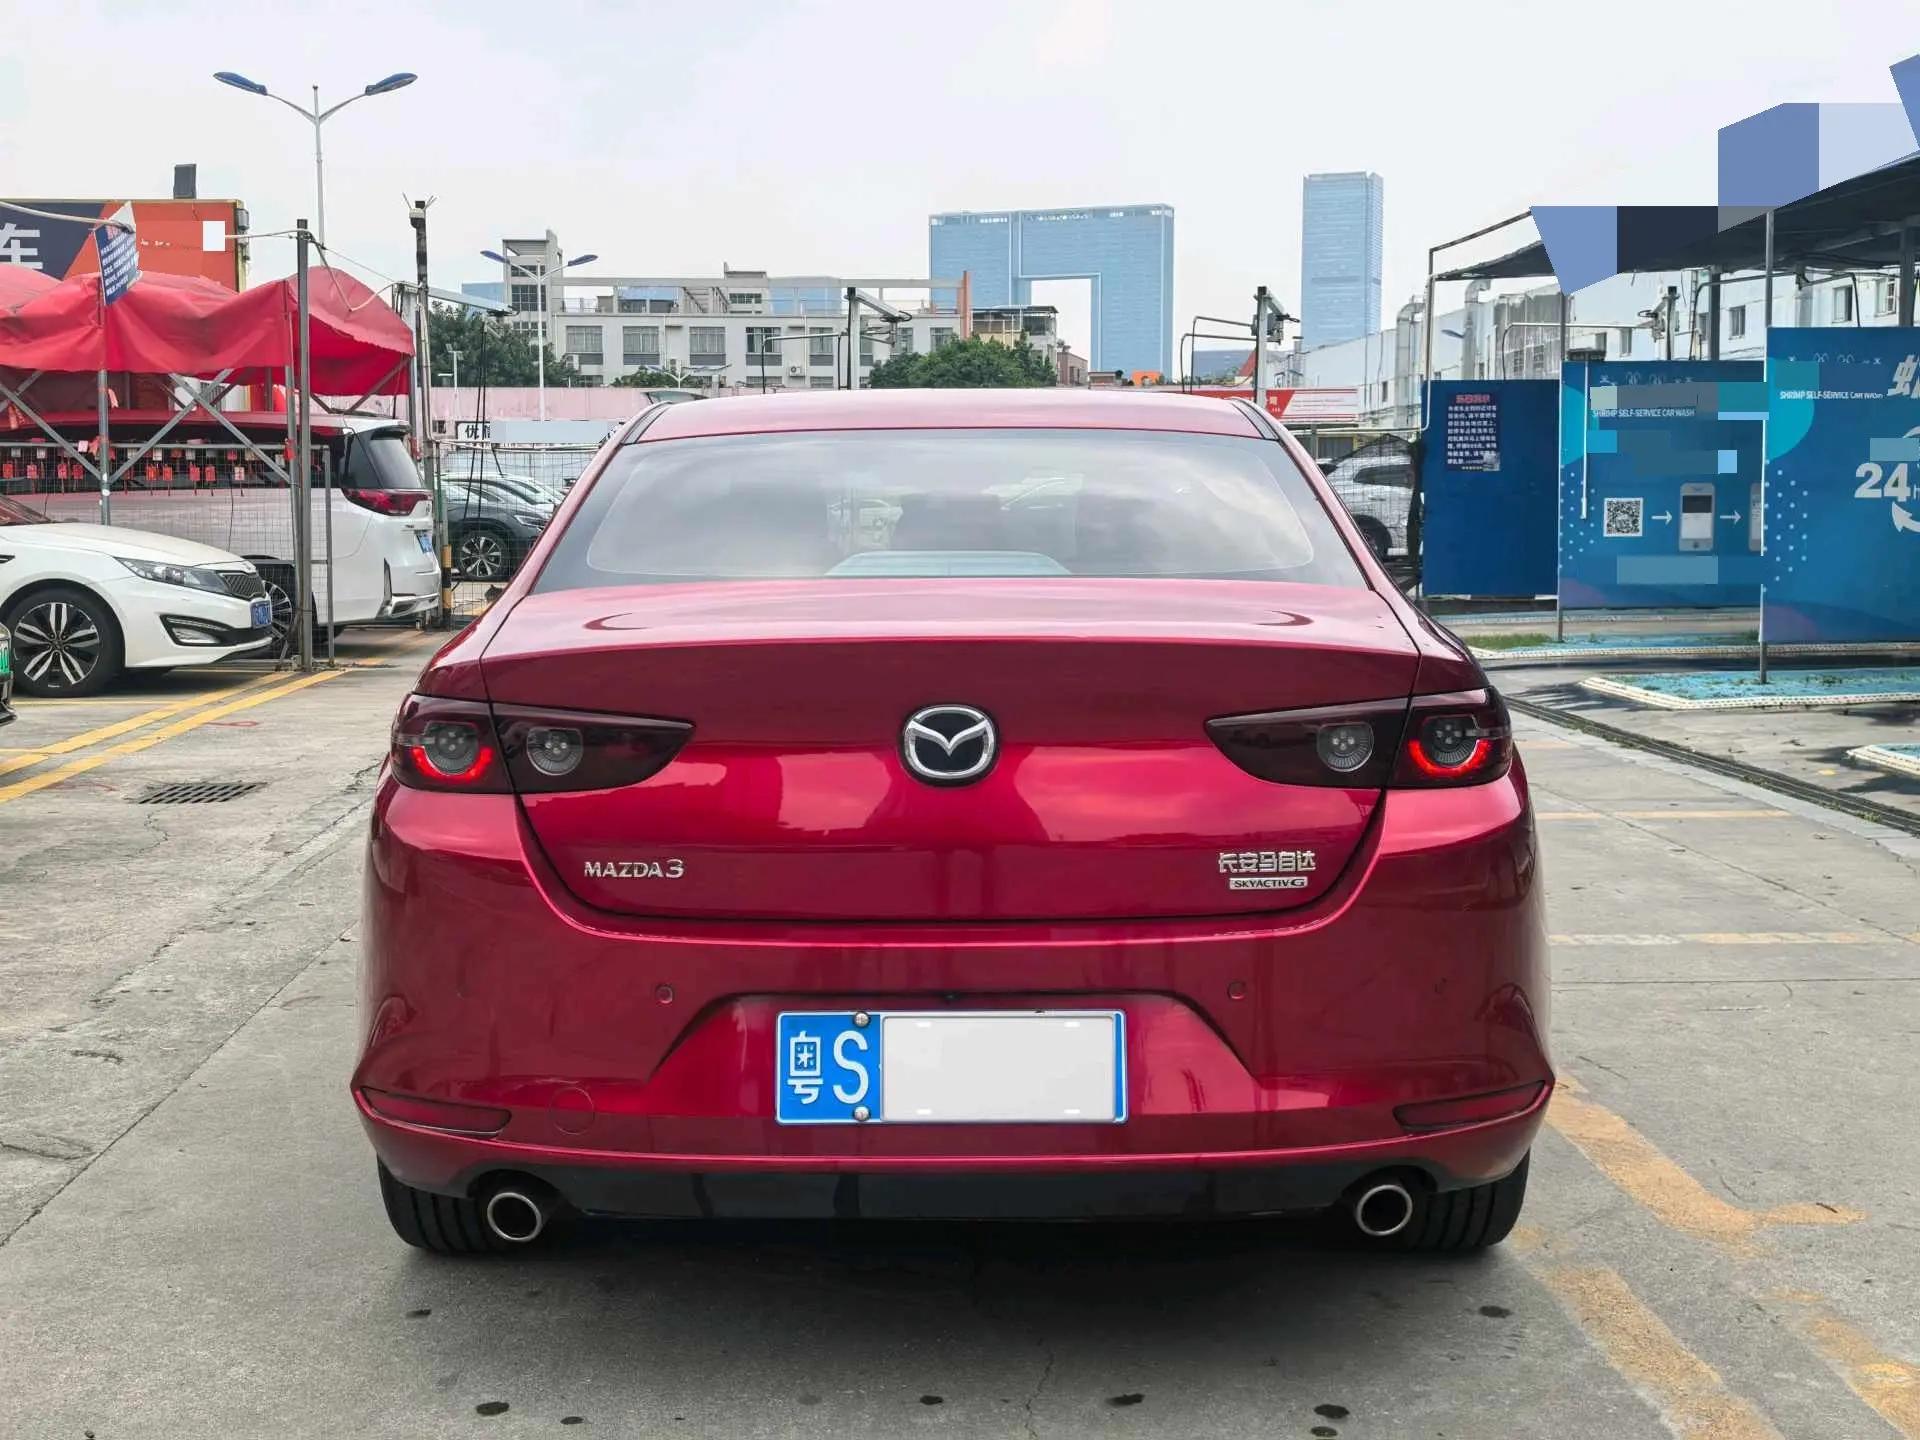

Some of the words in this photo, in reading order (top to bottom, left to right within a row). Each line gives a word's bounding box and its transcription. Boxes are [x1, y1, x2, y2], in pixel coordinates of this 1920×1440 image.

[1618, 408, 1661, 417] SELF-SERVICE
[1662, 408, 1674, 417] CAR
[1675, 408, 1695, 416] WASH
[1218, 850, 1316, 873] 长安马自达
